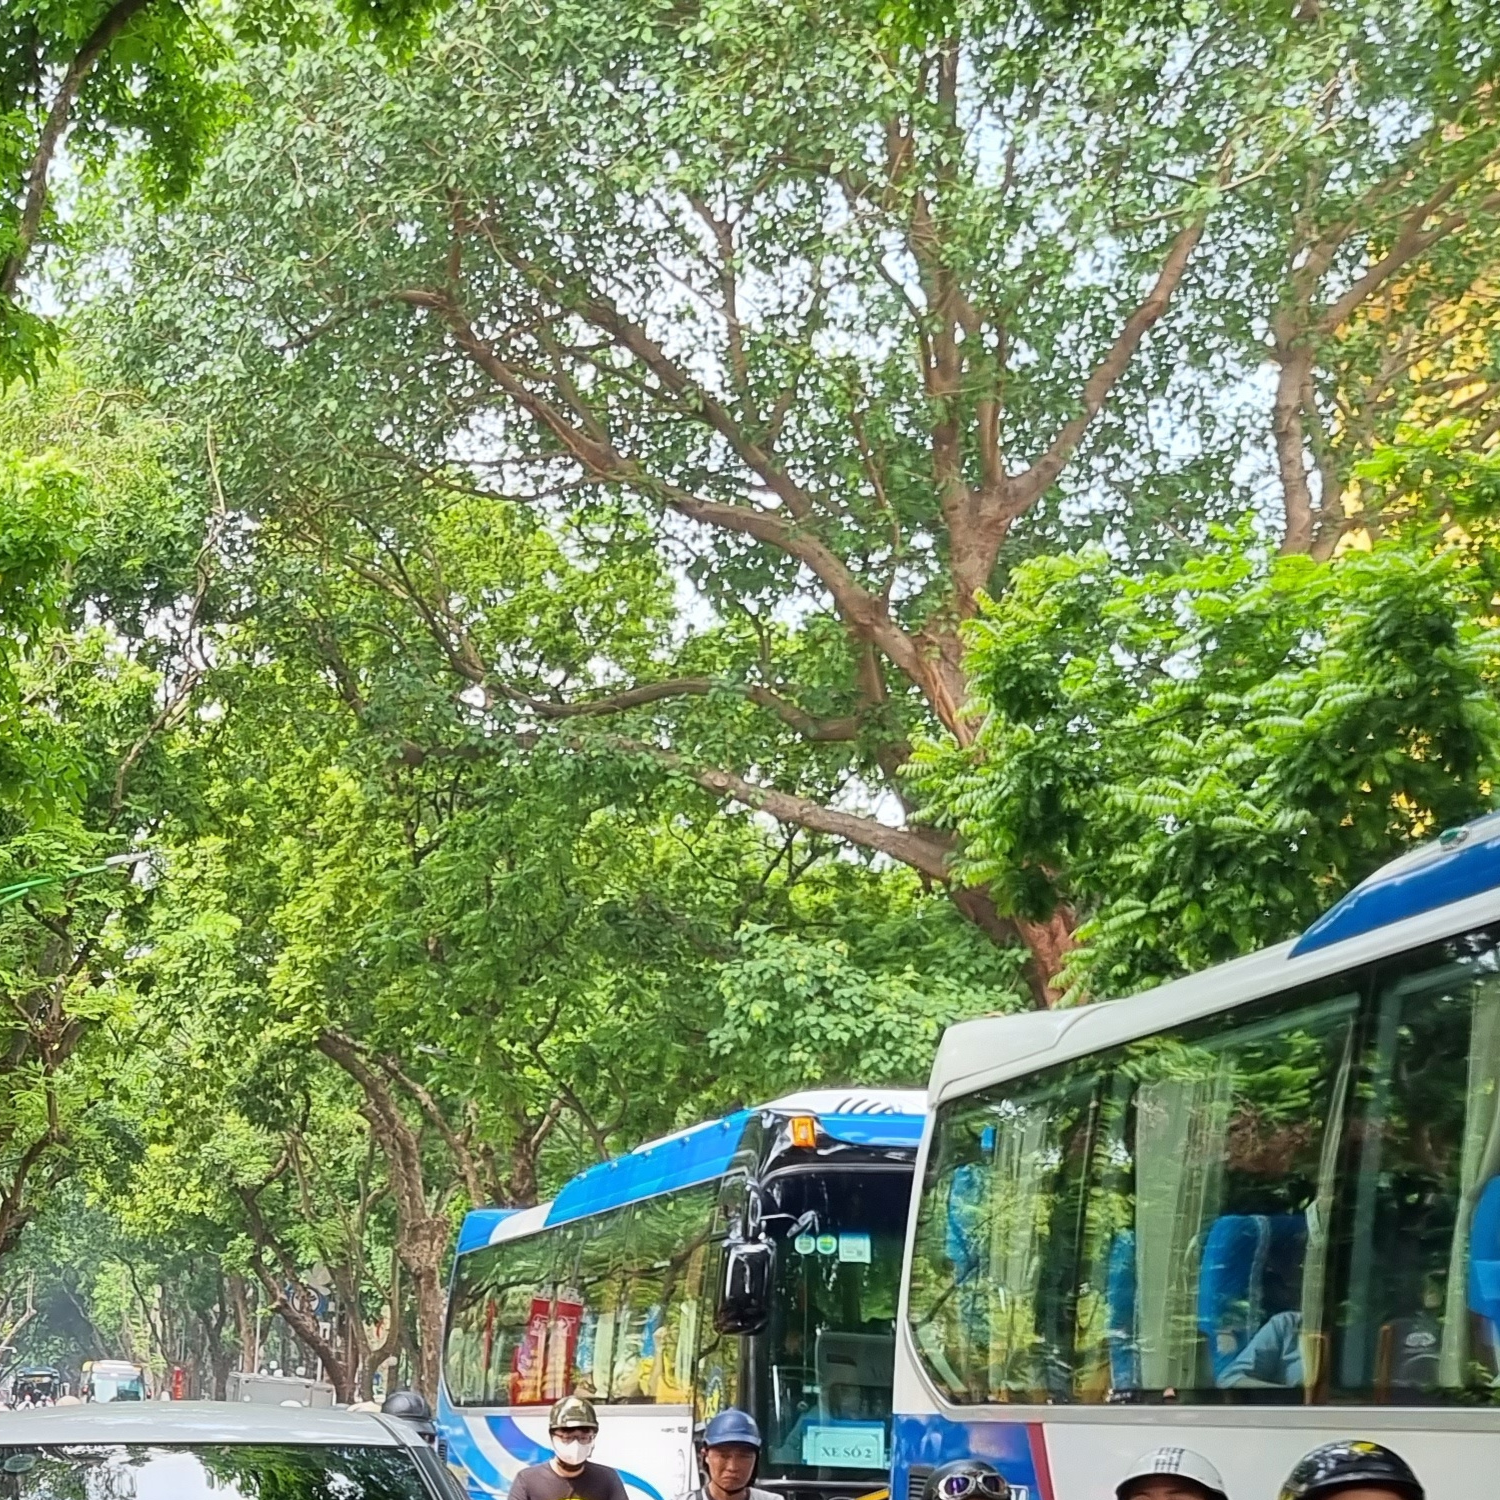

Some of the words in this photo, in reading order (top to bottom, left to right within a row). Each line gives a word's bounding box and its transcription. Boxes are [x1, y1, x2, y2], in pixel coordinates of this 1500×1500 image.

[821, 1446, 840, 1457] XE
[843, 1444, 862, 1458] SỐ
[864, 1448, 873, 1459] 2
